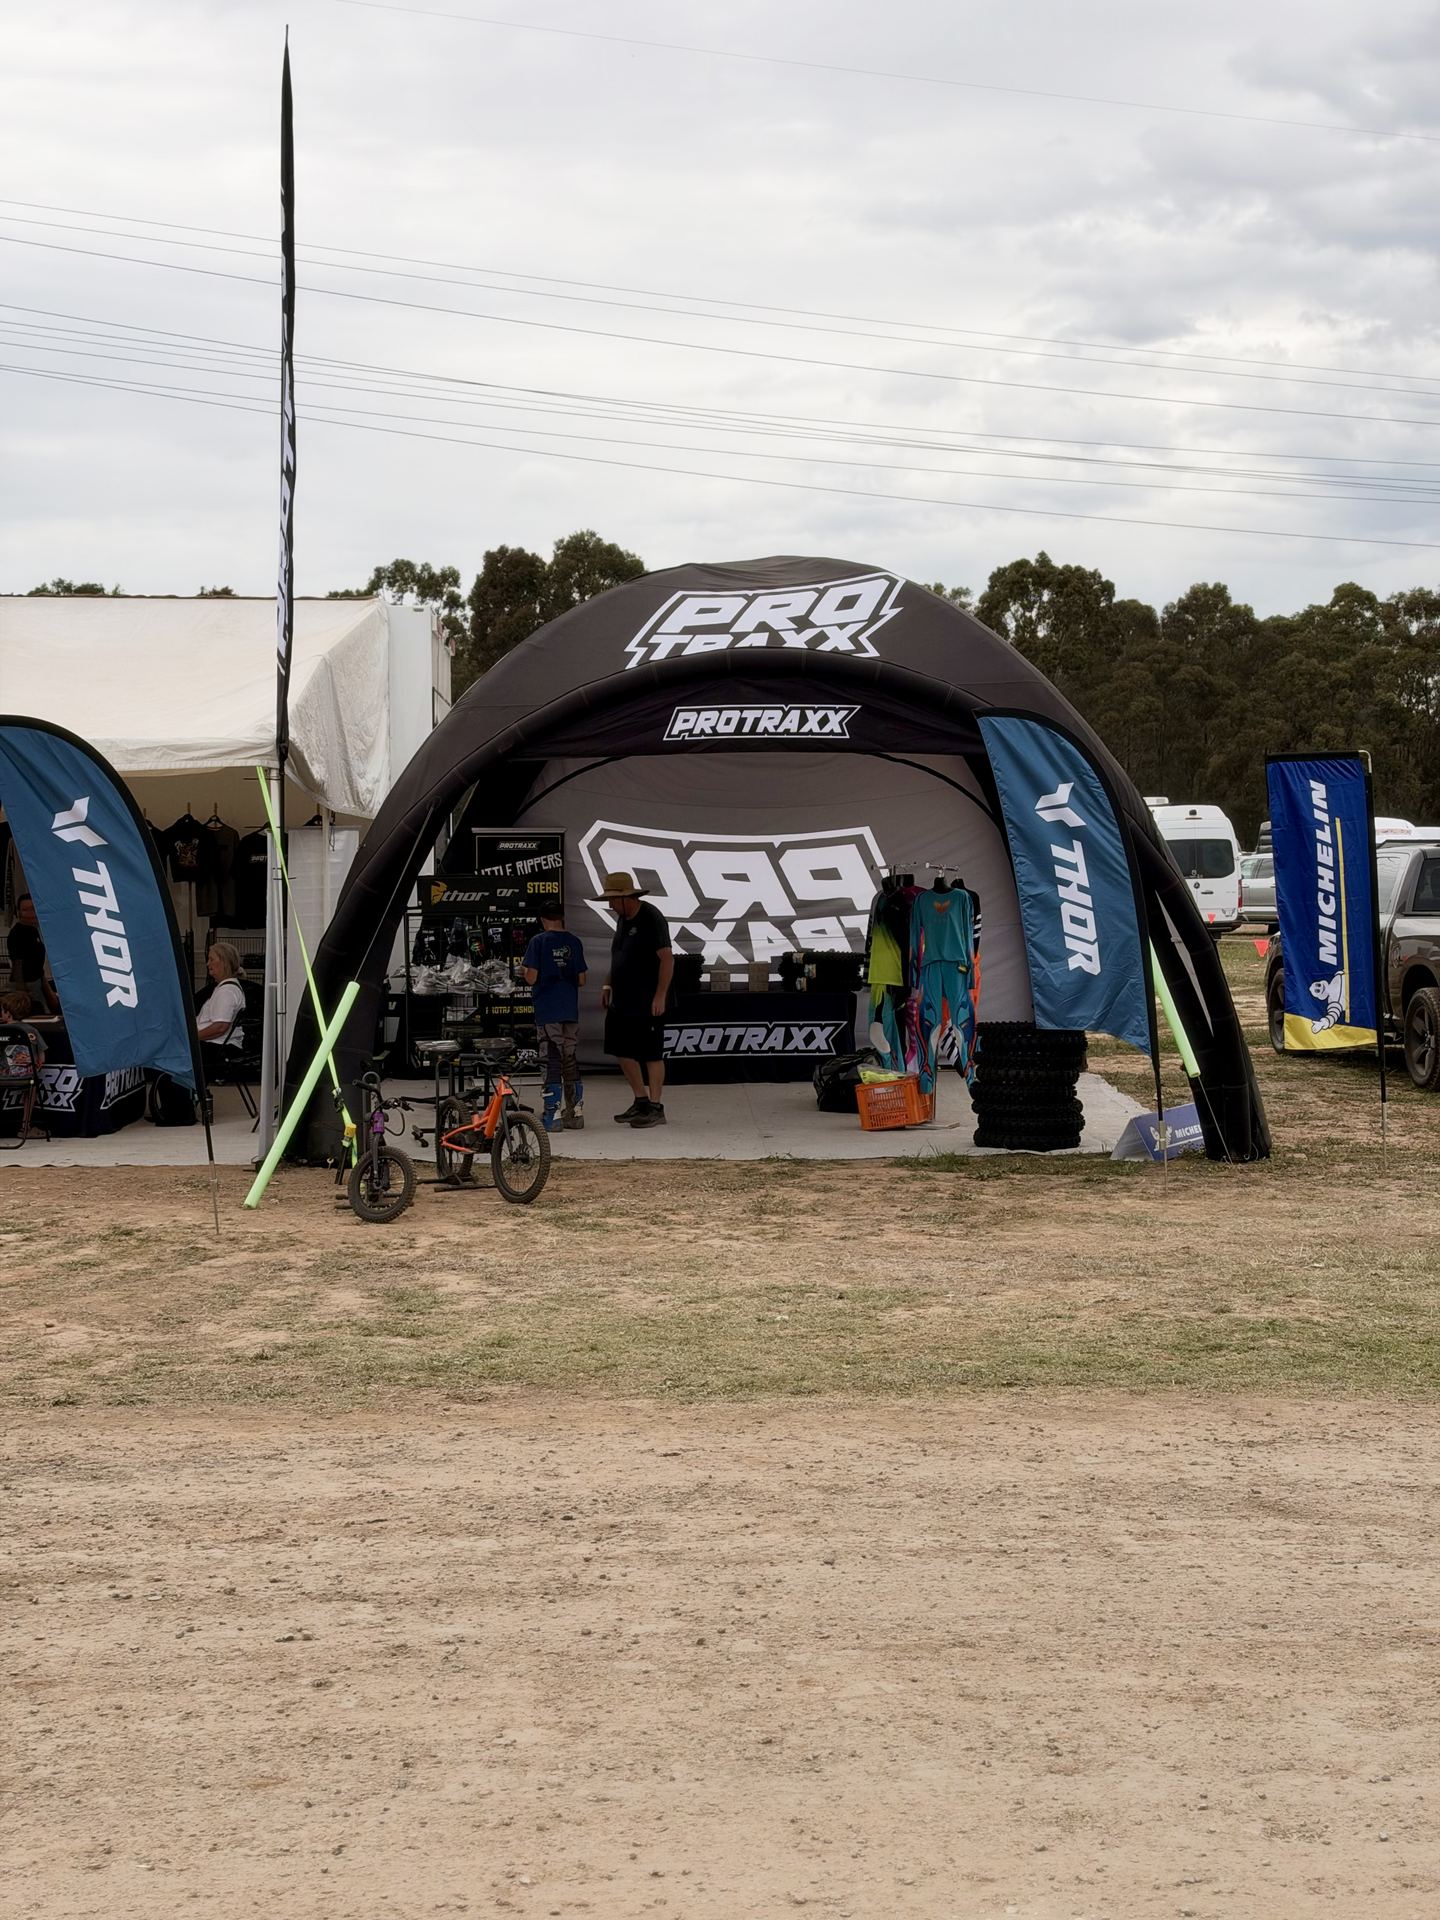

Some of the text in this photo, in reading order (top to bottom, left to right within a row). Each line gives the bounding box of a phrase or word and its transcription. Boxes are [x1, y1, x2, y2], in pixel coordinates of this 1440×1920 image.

[655, 577, 891, 634] PRO
[671, 709, 851, 736] PROTRAXX
[498, 842, 538, 850] PROTRAXX
[515, 852, 563, 877] RIPPERS
[1308, 778, 1339, 967] MICHELIN
[442, 888, 490, 902] thor
[526, 881, 559, 894] STERS
[1050, 839, 1102, 976] THOR
[71, 860, 140, 1009] THOR
[663, 1026, 836, 1051] PROTRAXX
[1174, 1124, 1203, 1139] MICHEL
